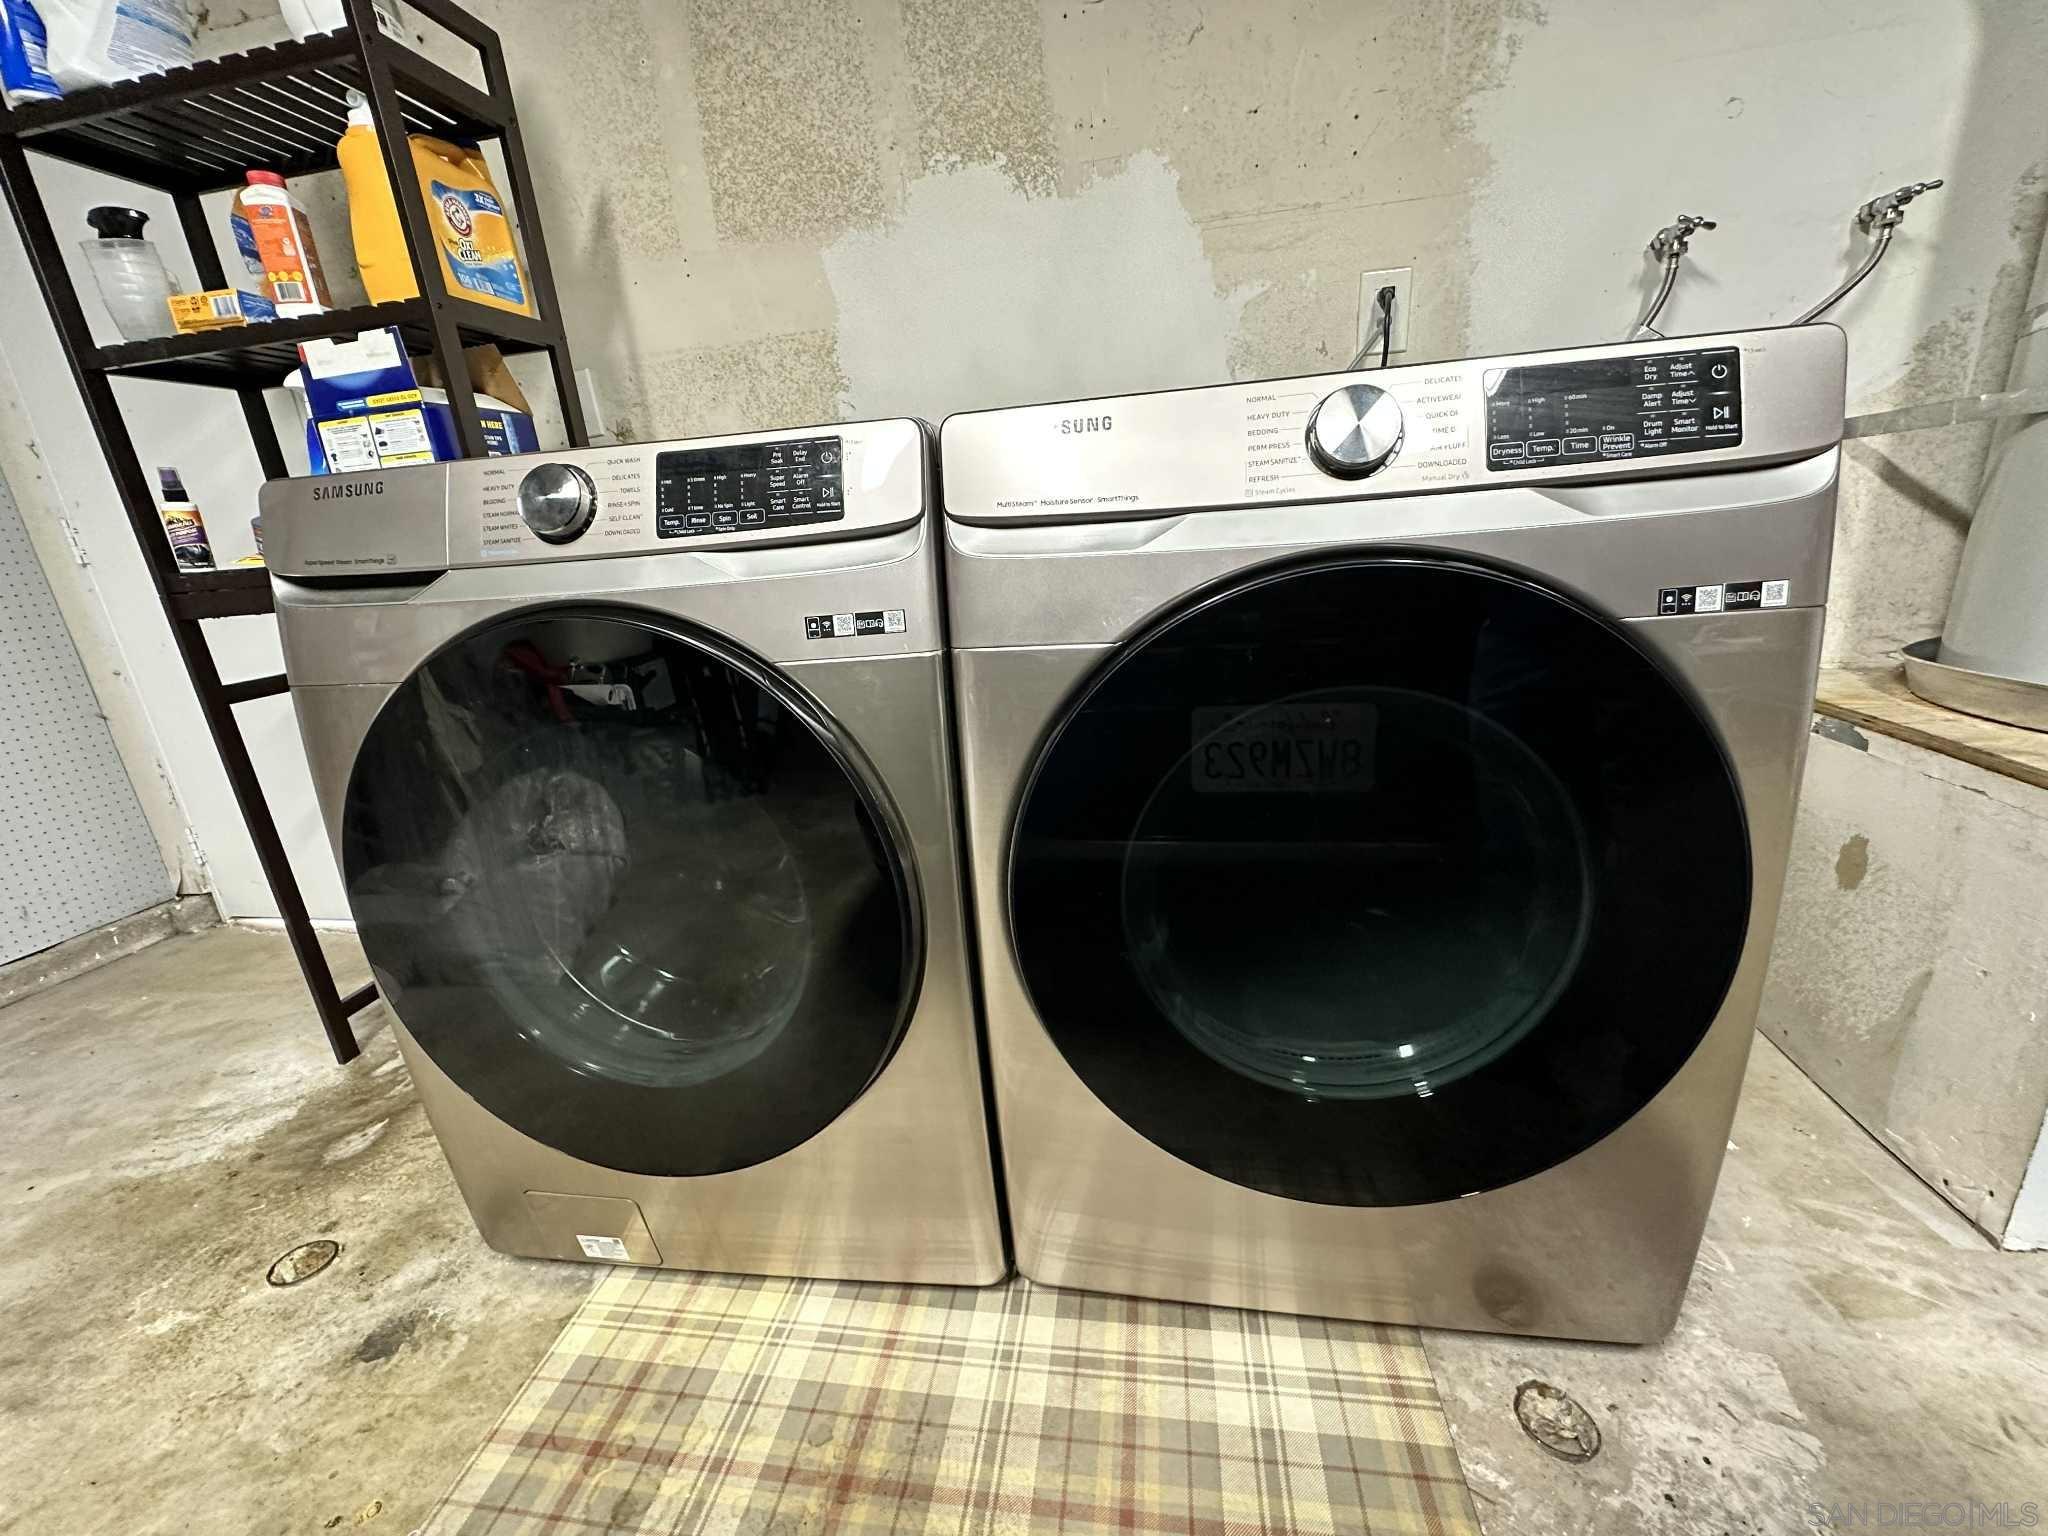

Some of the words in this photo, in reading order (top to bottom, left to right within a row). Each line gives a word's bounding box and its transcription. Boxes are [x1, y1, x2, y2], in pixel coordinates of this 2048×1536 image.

[459, 238, 473, 250] OXI
[458, 247, 482, 260] CLEAN
[1672, 390, 1694, 398] Adjust
[1246, 395, 1277, 404] NORMAL
[1272, 411, 1290, 419] DUTY
[1425, 411, 1449, 420] QUICK
[1060, 416, 1112, 434] SUNG
[1247, 428, 1279, 437] BEDDING
[1644, 428, 1662, 436] Light
[1602, 434, 1631, 442] Wrinkle
[1532, 445, 1554, 453] Temp.
[1570, 442, 1589, 450] Time
[1602, 442, 1631, 450] Prevent
[1493, 447, 1522, 456] Dryness
[1248, 459, 1270, 468] STEAM
[1418, 458, 1467, 469] DOWNLOADED
[1249, 475, 1279, 483] REFRESH
[313, 481, 384, 501] SAMSUNG
